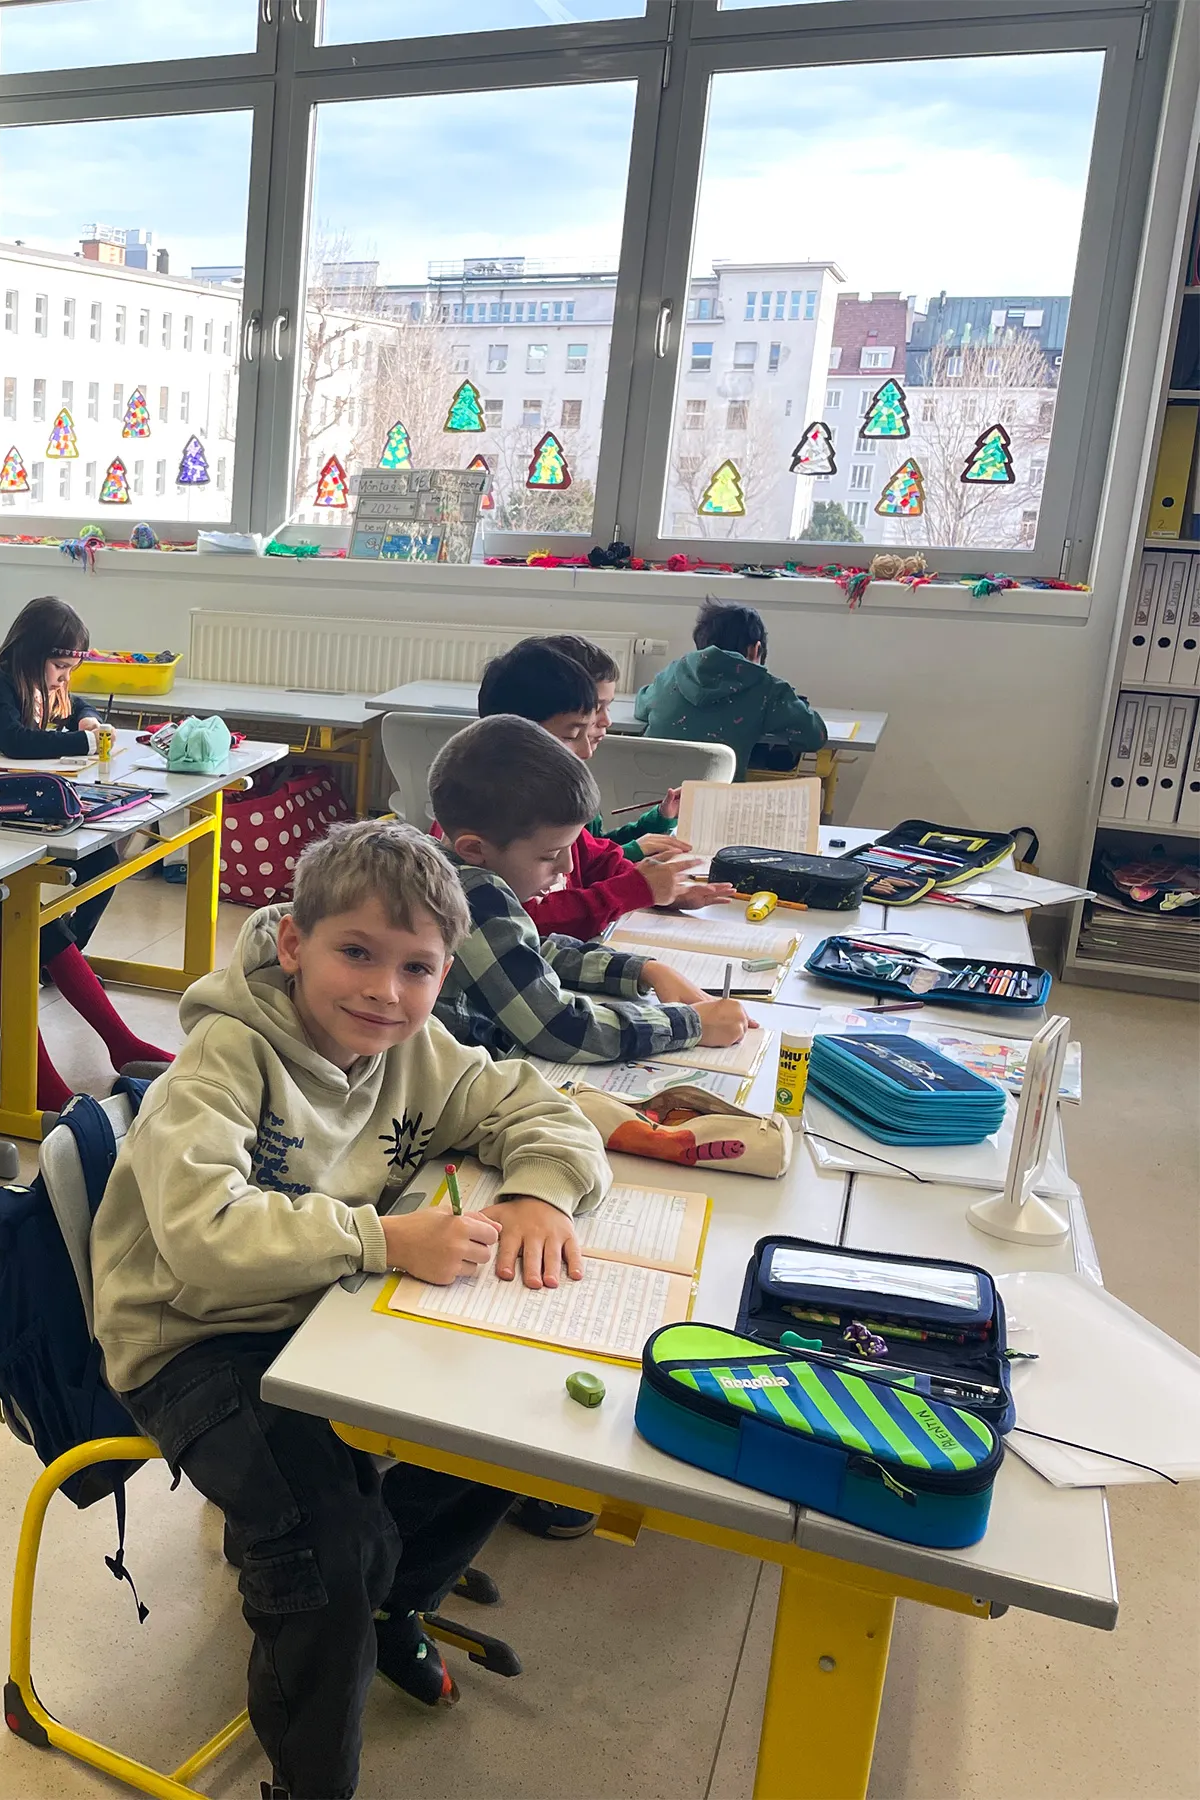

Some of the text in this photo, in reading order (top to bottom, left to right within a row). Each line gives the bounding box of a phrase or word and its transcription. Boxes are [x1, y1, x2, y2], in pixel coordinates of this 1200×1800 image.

[370, 502, 400, 514] 2024
[780, 1048, 802, 1062] UHU
[780, 1061, 797, 1071] stic
[719, 1374, 790, 1390] ergobag
